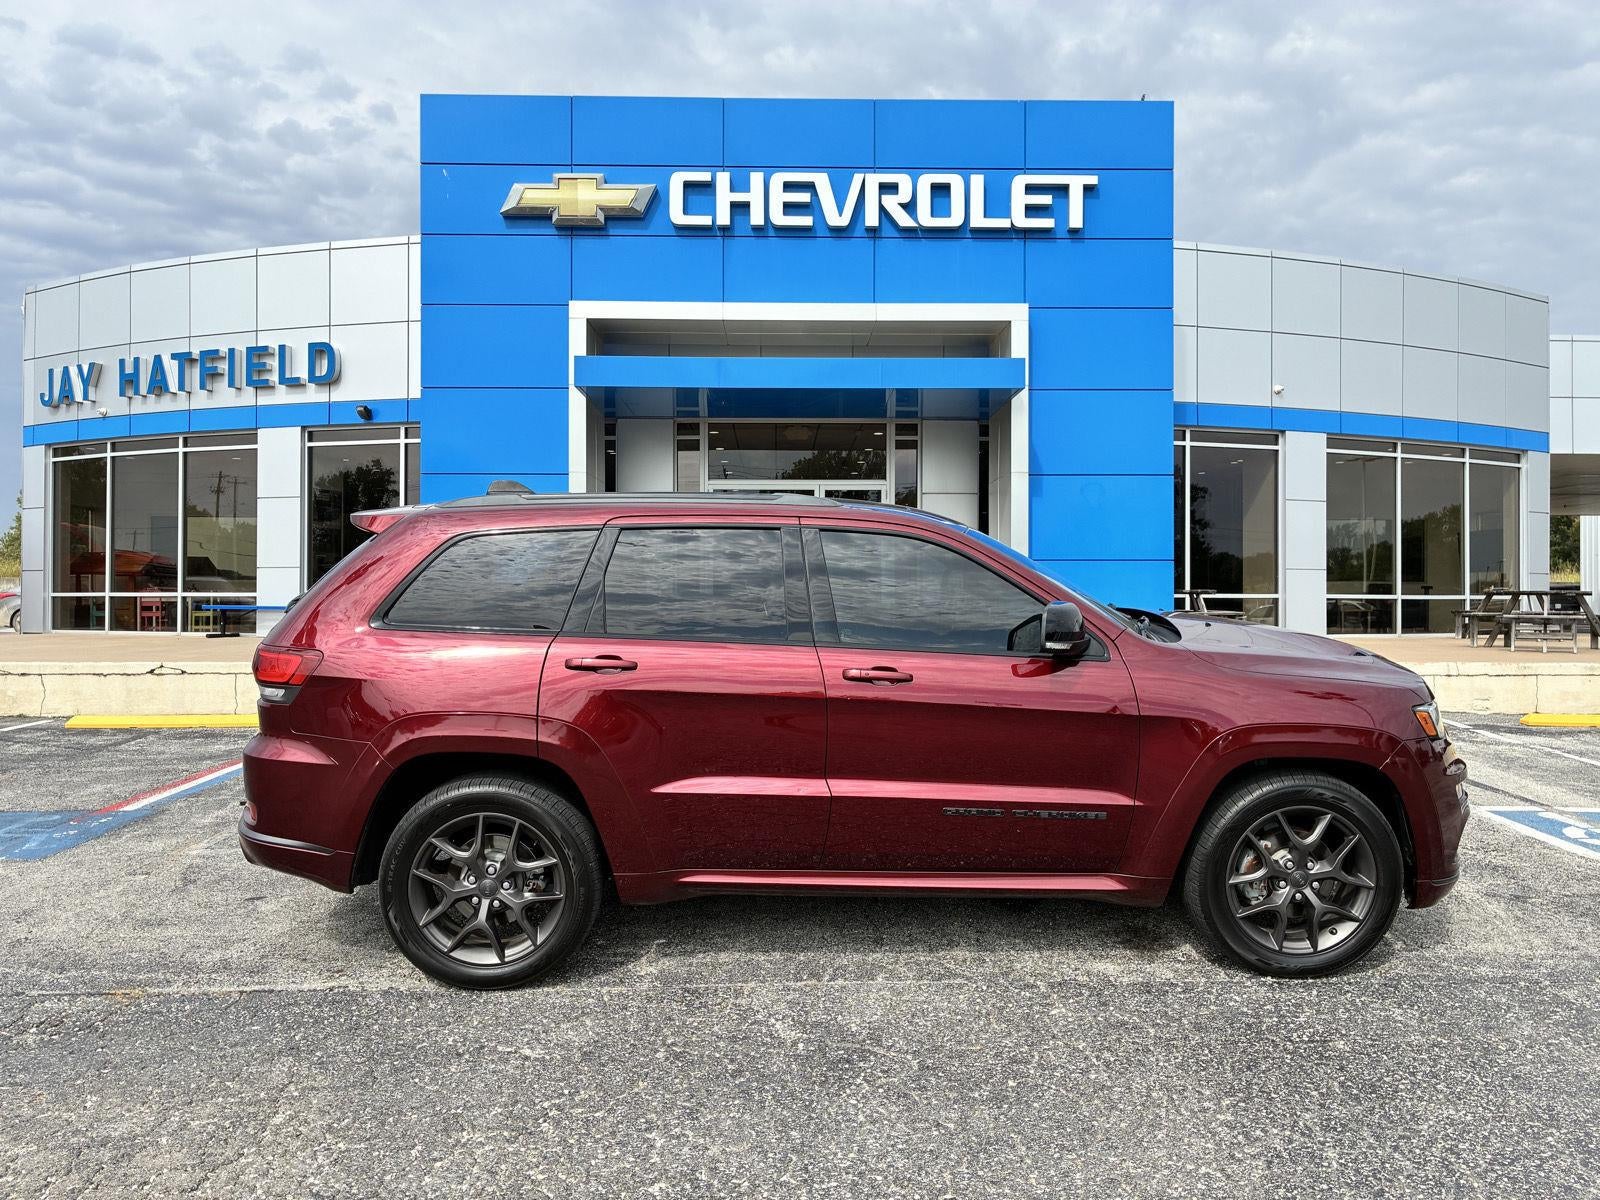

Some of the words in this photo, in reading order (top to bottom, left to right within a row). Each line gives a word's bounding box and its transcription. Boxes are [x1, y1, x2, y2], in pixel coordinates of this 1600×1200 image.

[668, 170, 1099, 231] CHEVROLET
[40, 361, 102, 408] JAY
[118, 341, 342, 397] HATFIELD
